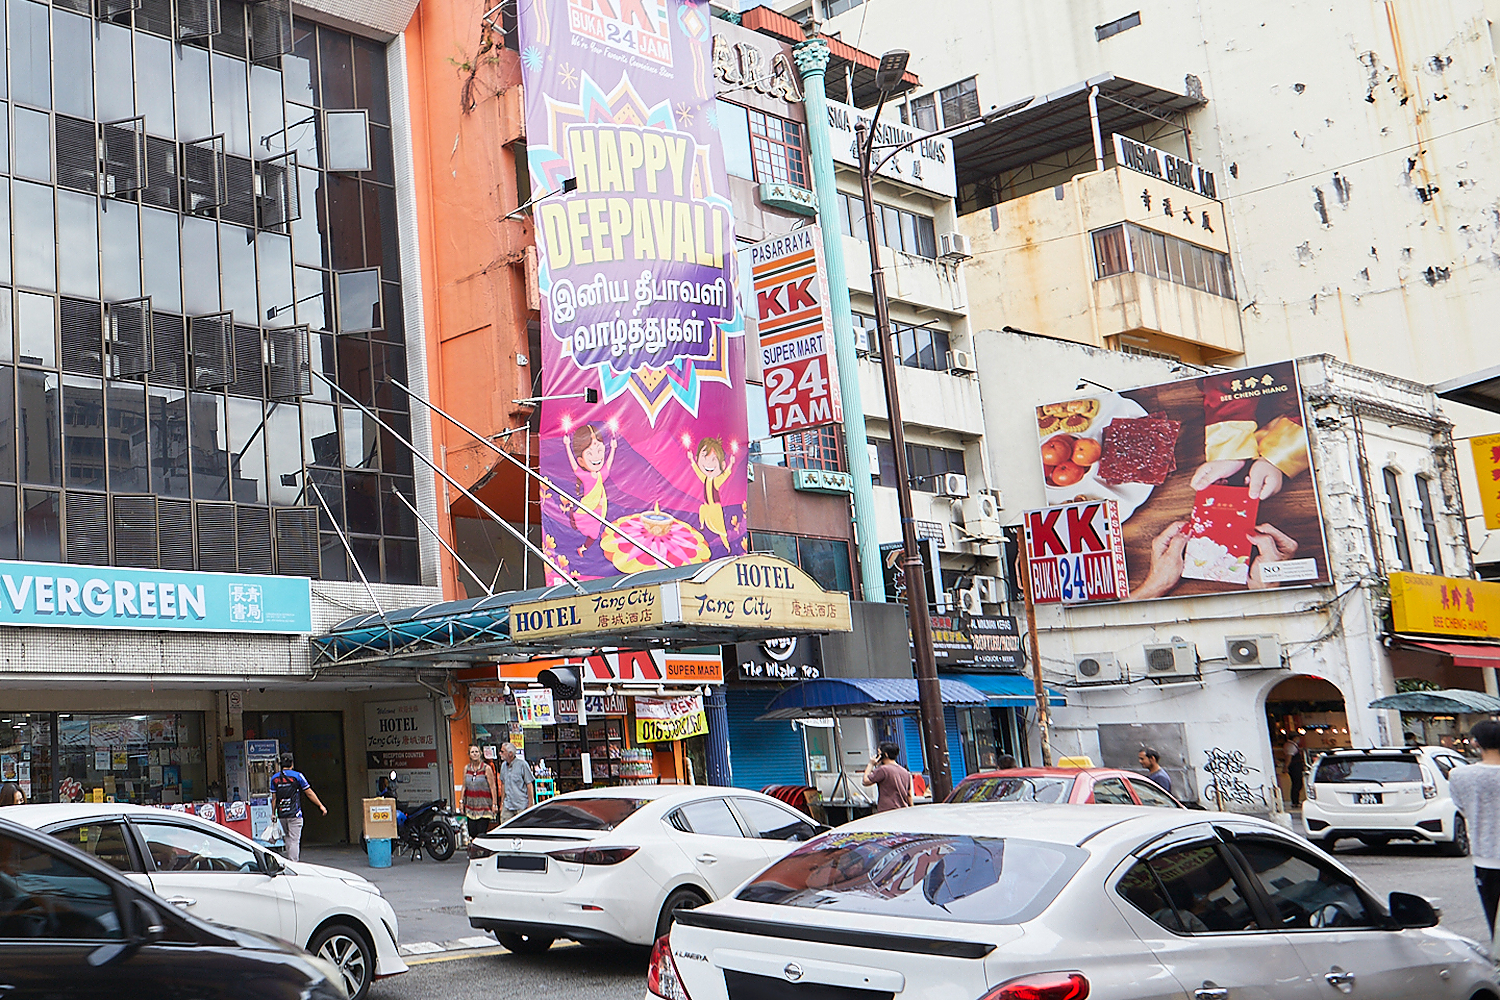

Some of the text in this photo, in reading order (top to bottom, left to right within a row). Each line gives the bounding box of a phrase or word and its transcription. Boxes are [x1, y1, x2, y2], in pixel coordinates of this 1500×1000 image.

[572, 9, 671, 61] BUKA 24 JAM
[569, 129, 687, 196] HAPPY
[541, 198, 725, 270] DEEPAVALI
[552, 269, 728, 323] இனிய தீபாவளி
[757, 276, 818, 320] KK
[763, 335, 823, 365] SUPER MART
[765, 359, 828, 407] 24
[1233, 390, 1261, 400] CHENG
[1262, 384, 1288, 395] HIANG
[771, 397, 832, 431] JAM
[1030, 504, 1106, 557] KK
[735, 563, 795, 590] HOTEL
[1032, 555, 1114, 600] BUKA 24 JAM
[591, 588, 656, 611] Tang City
[695, 594, 773, 620] Tang City
[791, 601, 837, 618] 唐城酒店
[515, 605, 582, 632] HOTEL
[597, 608, 653, 628] 唐城酒店
[1433, 616, 1488, 632] BEE CHENG HIANG
[668, 664, 720, 676] SUPER MART
[742, 660, 763, 677] The
[765, 662, 797, 679] Whale
[379, 717, 418, 733] HOTEL
[386, 735, 401, 748] City
